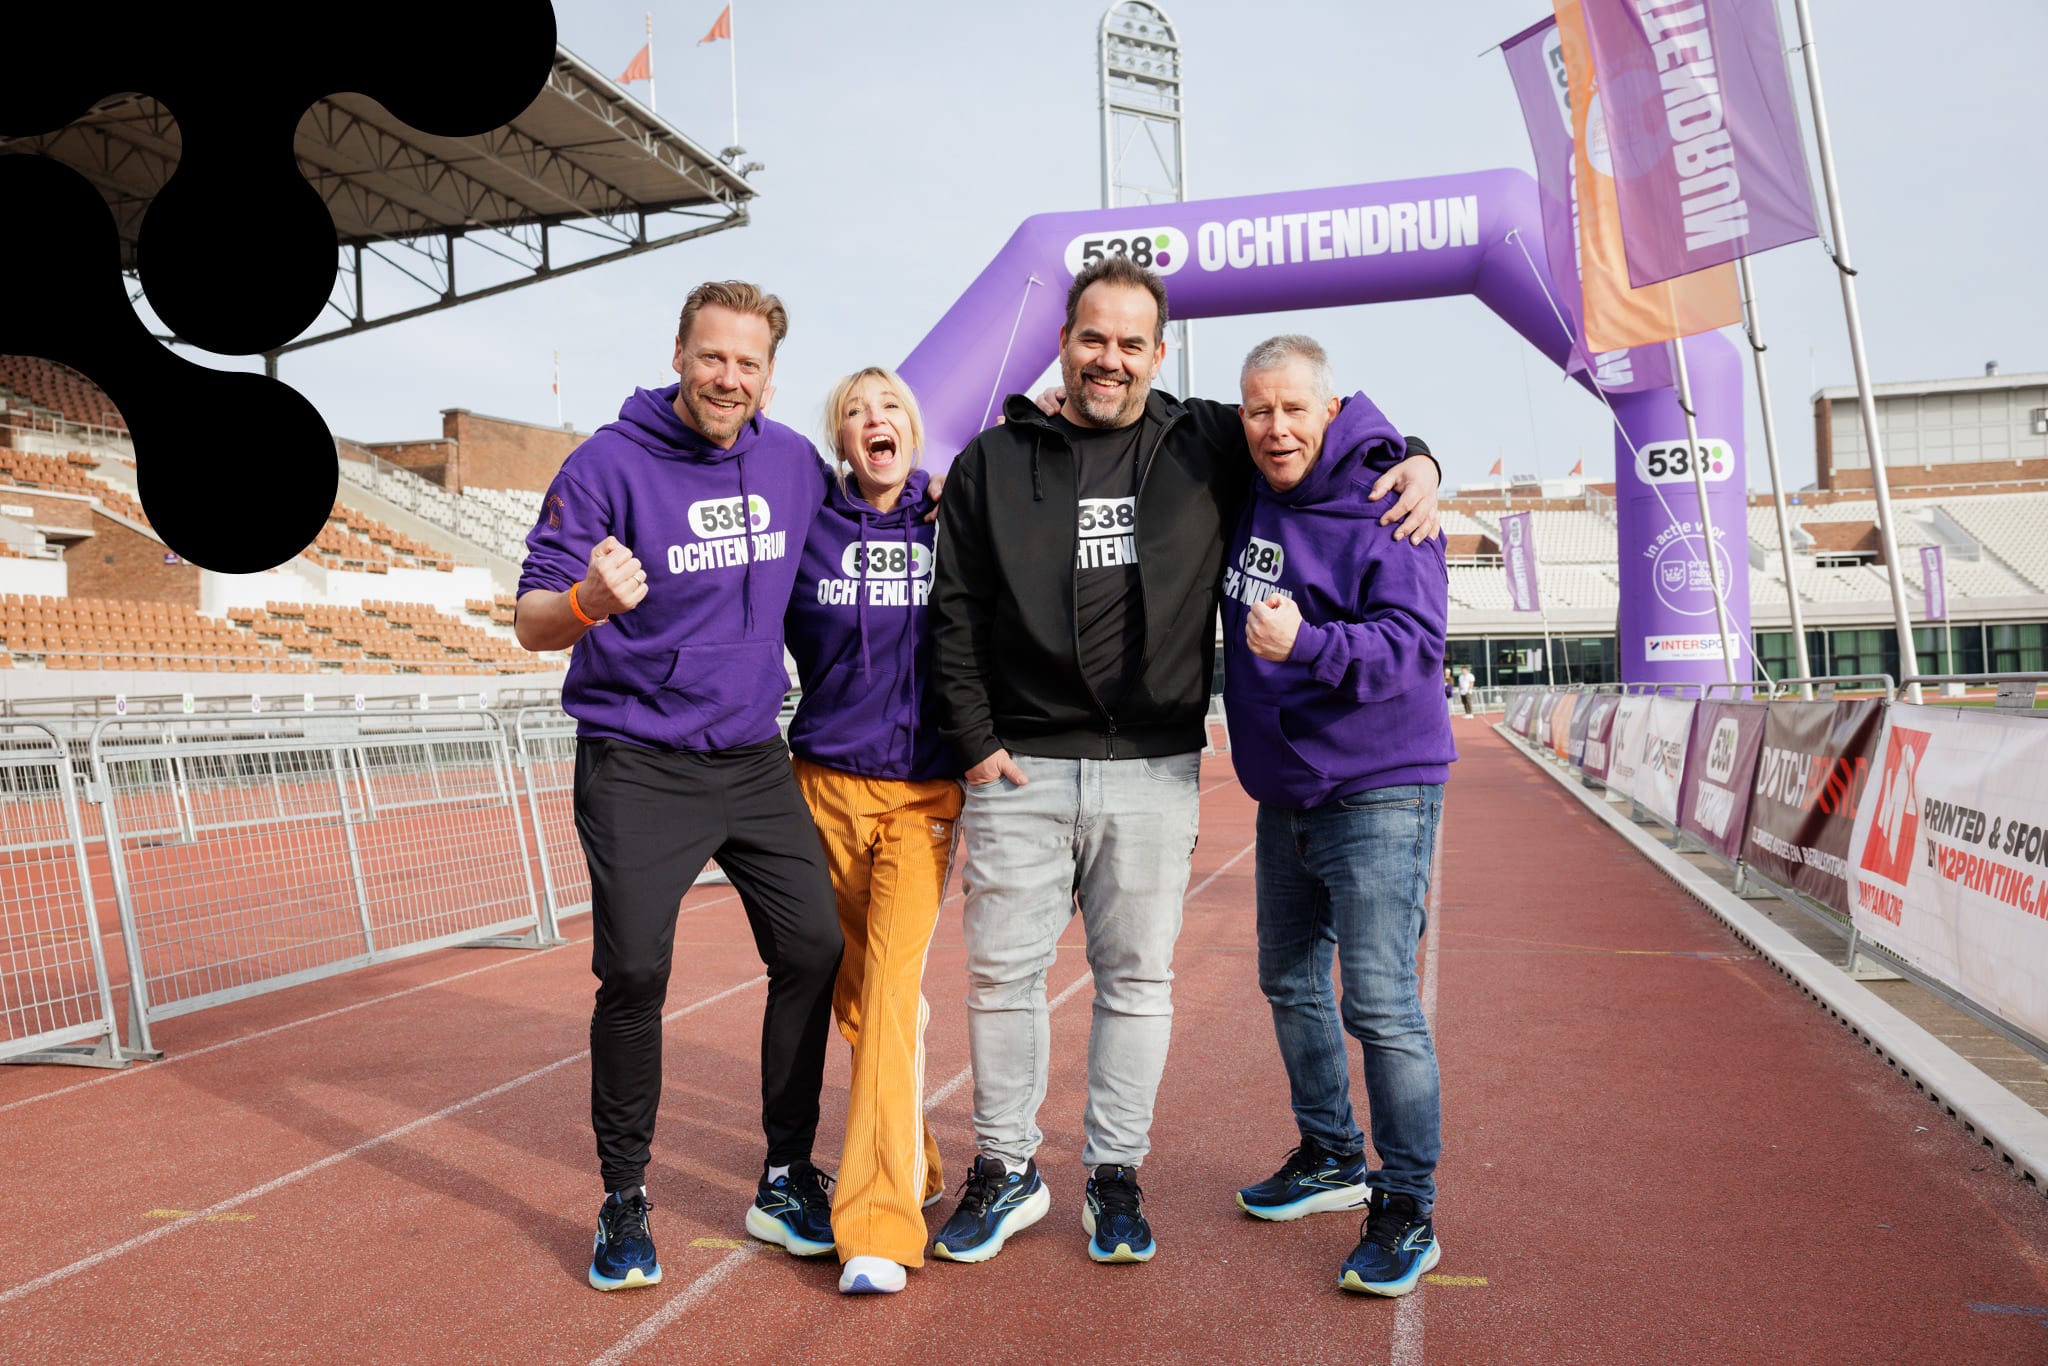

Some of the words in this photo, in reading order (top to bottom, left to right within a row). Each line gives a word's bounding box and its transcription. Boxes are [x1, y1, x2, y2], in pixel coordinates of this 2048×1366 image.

[1198, 195, 1479, 272] OCHTENDRUN
[700, 502, 748, 532] 538
[1078, 503, 1135, 531] 538
[1643, 544, 1659, 559] in
[1694, 521, 1726, 539] vor
[853, 547, 906, 573] 538
[1247, 542, 1275, 574] 38
[1661, 638, 1736, 650] INTERSPOT
[1924, 796, 1986, 845] PRINTED
[1988, 815, 2002, 851] &
[1938, 842, 2048, 922] M2PRINTING.N
